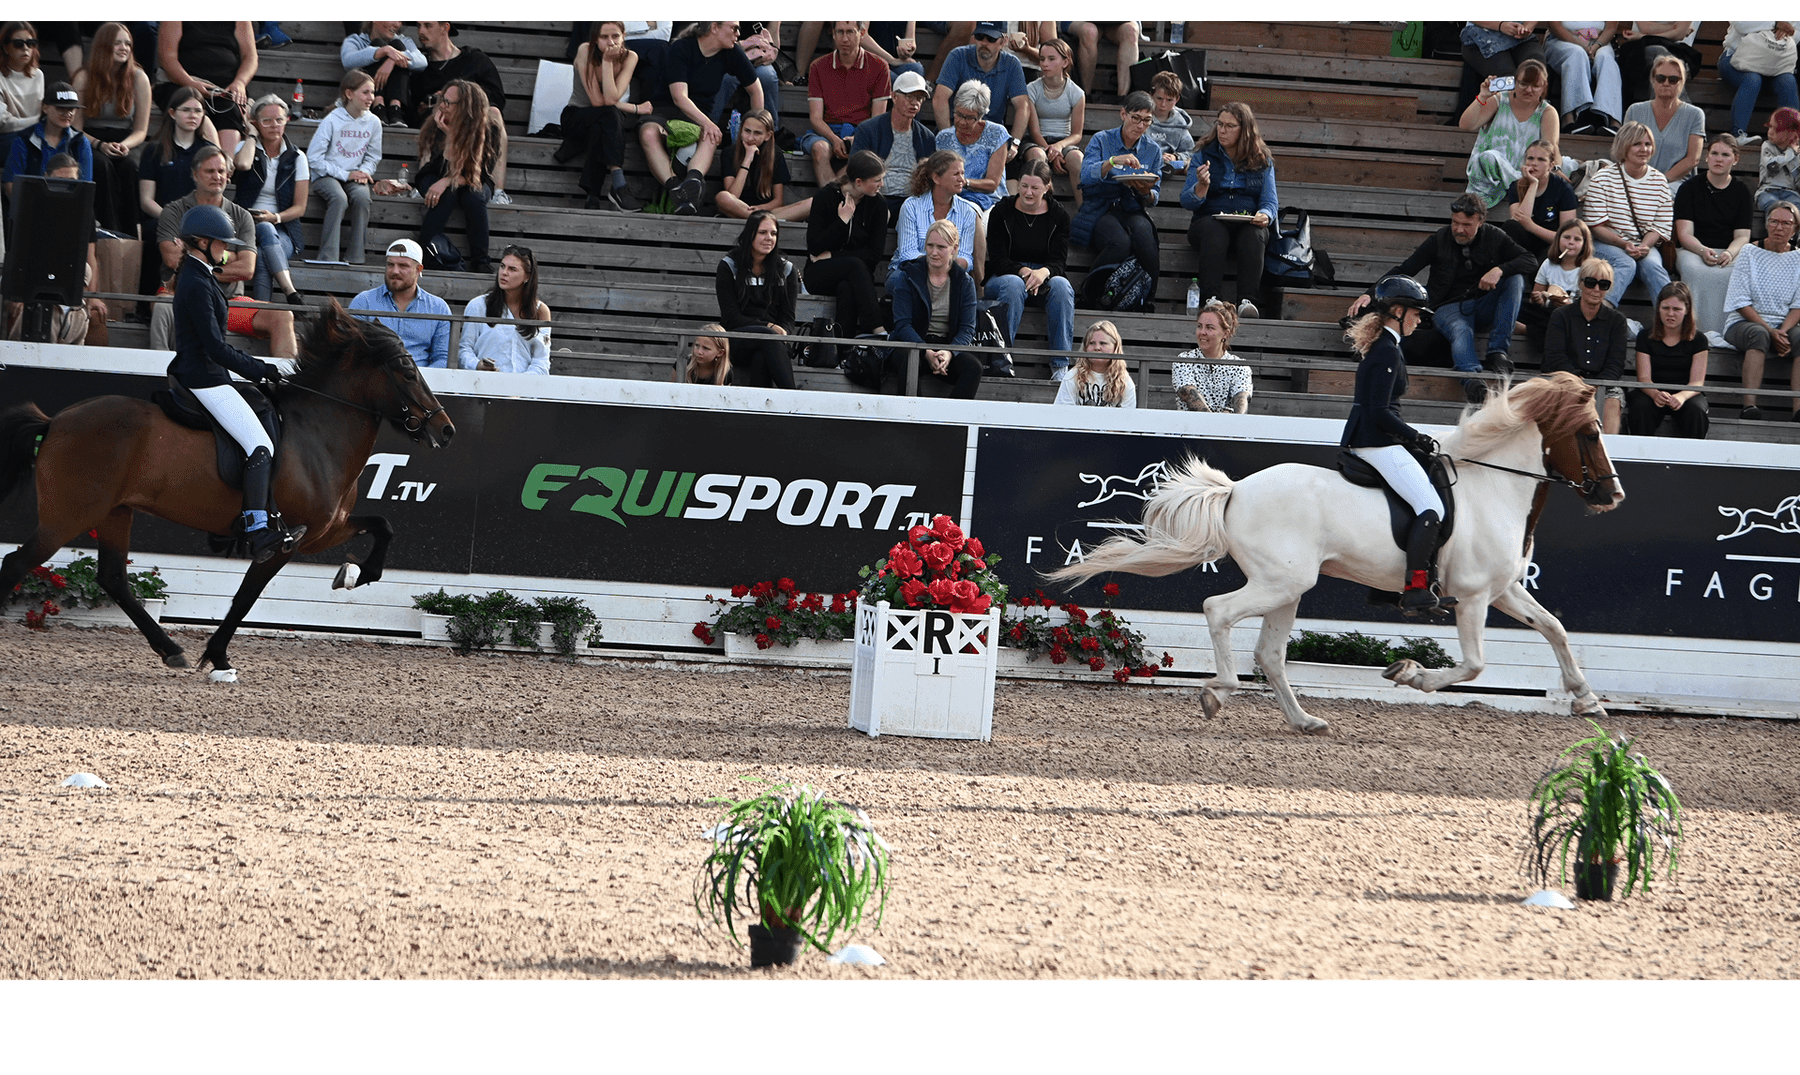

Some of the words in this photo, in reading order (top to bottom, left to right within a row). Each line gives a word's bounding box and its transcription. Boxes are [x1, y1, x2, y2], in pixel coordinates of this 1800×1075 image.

[340, 129, 371, 139] HELLO
[1665, 568, 1800, 603] FAG
[923, 611, 955, 655] R
[932, 657, 941, 674] I
